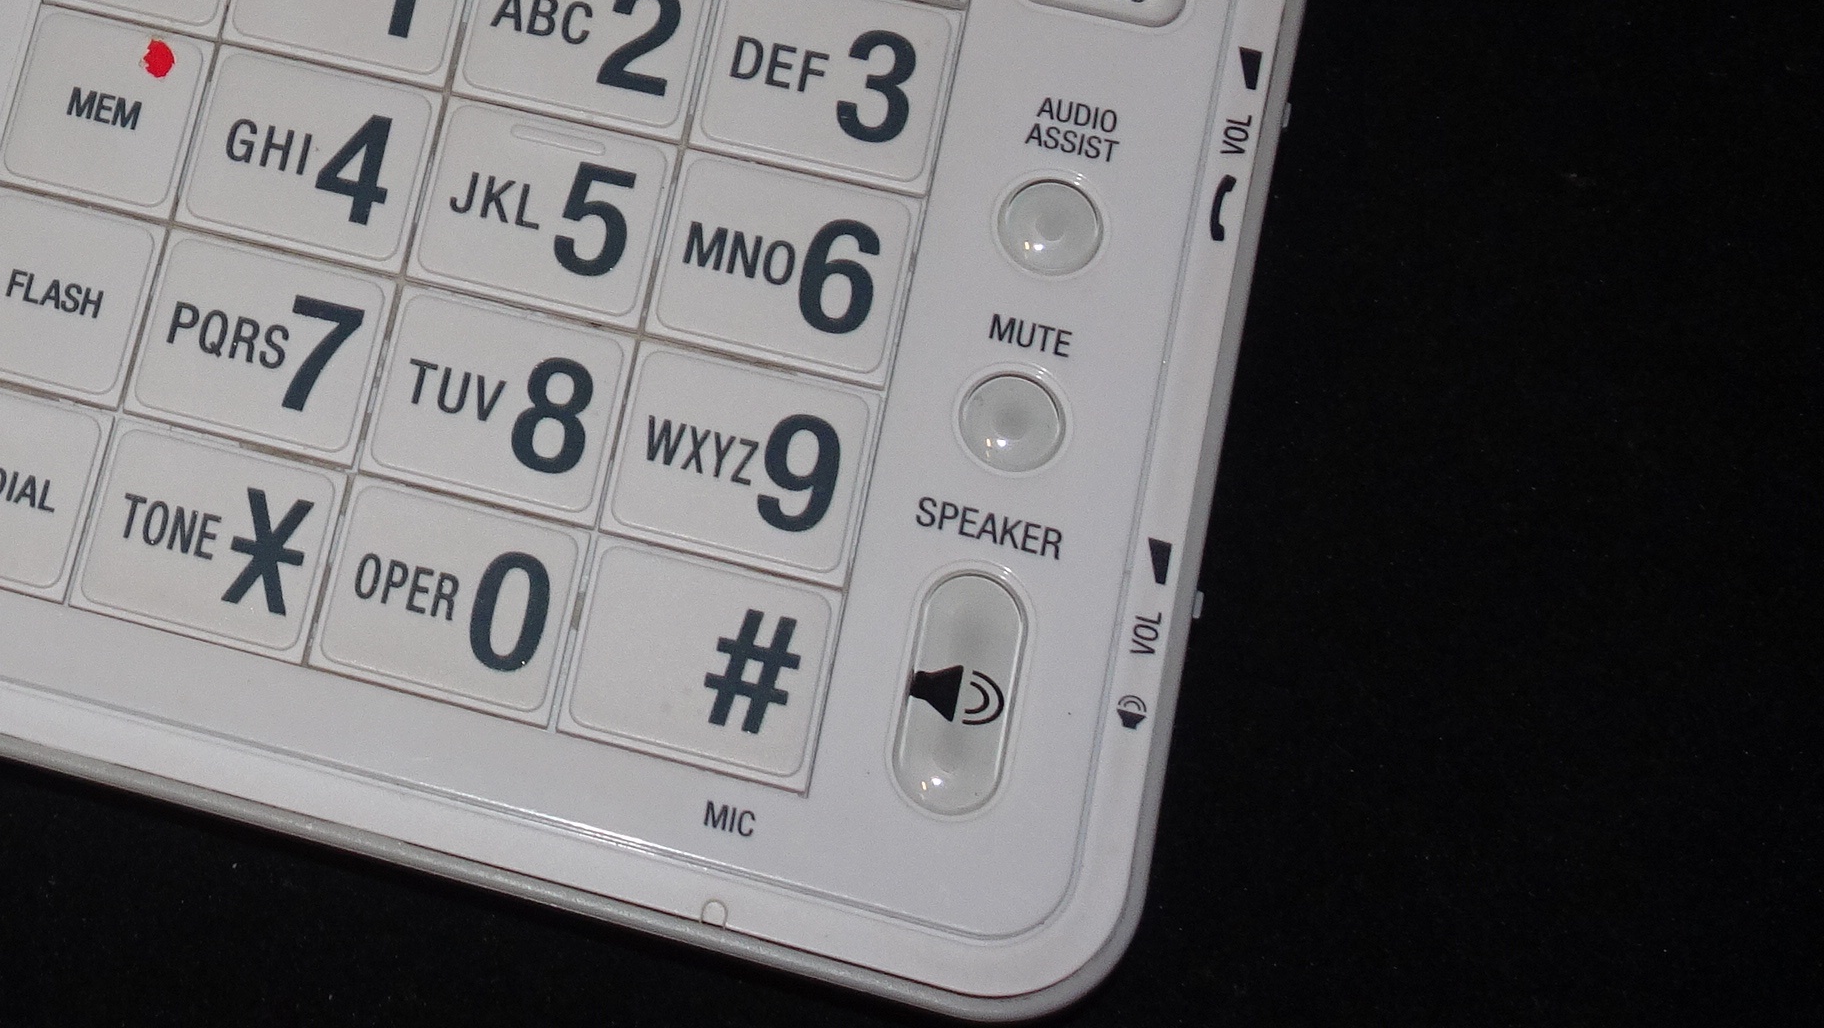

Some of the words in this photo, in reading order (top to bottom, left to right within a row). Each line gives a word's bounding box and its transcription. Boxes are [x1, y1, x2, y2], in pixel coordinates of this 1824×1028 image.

[66, 86, 143, 131] MEM
[729, 35, 830, 93] DEF
[836, 29, 917, 144] 3
[1036, 97, 1118, 134] AUDIO
[1024, 122, 1120, 163] ASSIST
[1220, 114, 1253, 155] VOL
[225, 118, 313, 176] GHI
[314, 114, 393, 226] 4
[449, 171, 540, 231] JKL
[553, 161, 637, 278] 5
[5, 268, 104, 319] FLASH
[682, 221, 796, 286] MNO
[798, 219, 881, 335] 6
[166, 301, 290, 370] PQRS
[281, 294, 365, 412] 7
[988, 313, 1073, 358] MUTE
[409, 358, 507, 422] TUV
[510, 357, 594, 475] 8
[646, 415, 760, 487] WXYZ
[756, 413, 841, 533] 9
[123, 492, 222, 561] TONE
[915, 496, 1063, 561] SPEAKER
[354, 552, 460, 622] OPER
[469, 551, 551, 673] 0
[1129, 612, 1163, 655] VOL
[703, 608, 802, 735] #
[703, 800, 756, 838] MIC
